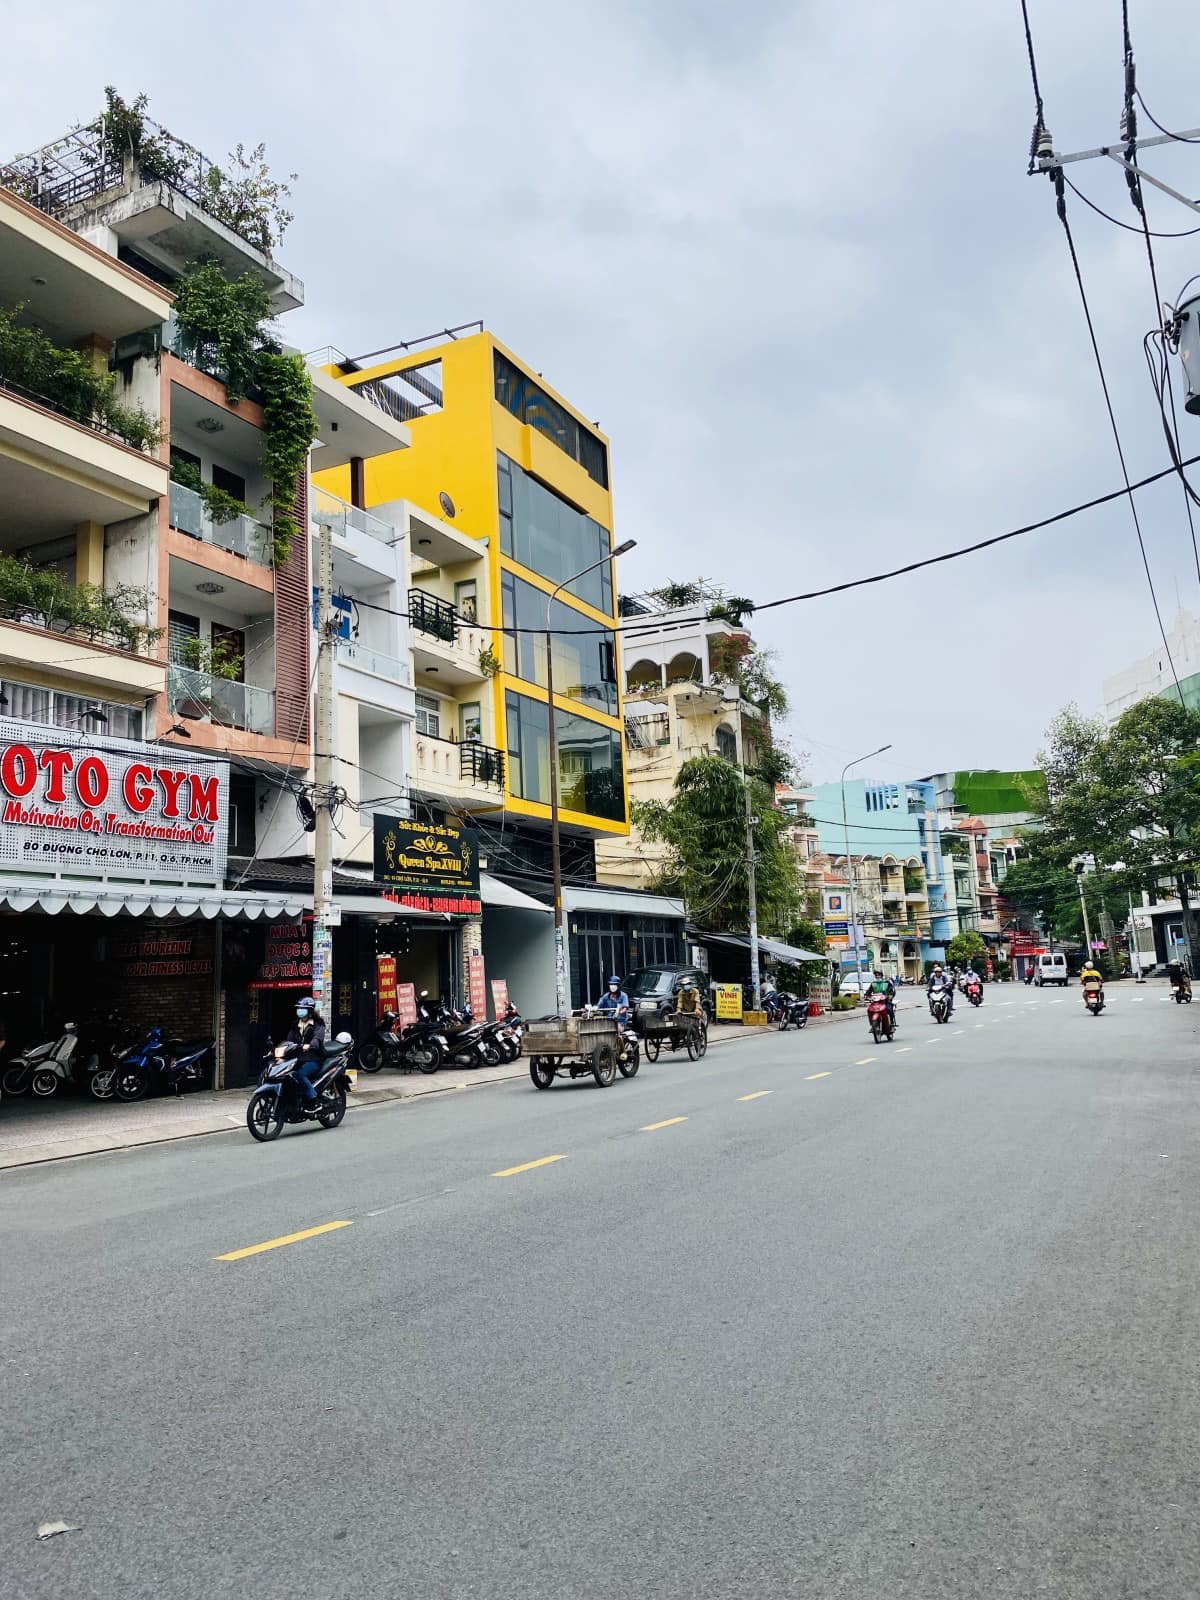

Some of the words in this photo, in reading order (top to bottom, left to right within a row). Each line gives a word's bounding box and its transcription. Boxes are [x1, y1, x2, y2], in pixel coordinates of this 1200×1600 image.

[1, 743, 109, 808] OTO
[123, 763, 220, 823] GYM
[3, 799, 79, 830] Motivation
[80, 809, 103, 834] On,
[106, 812, 192, 842] Transformation
[193, 823, 215, 845] Out
[23, 841, 39, 850] 80
[181, 856, 212, 865] TP.HCM
[398, 853, 424, 868] Queen
[300, 923, 307, 937] 1
[301, 942, 310, 957] 3
